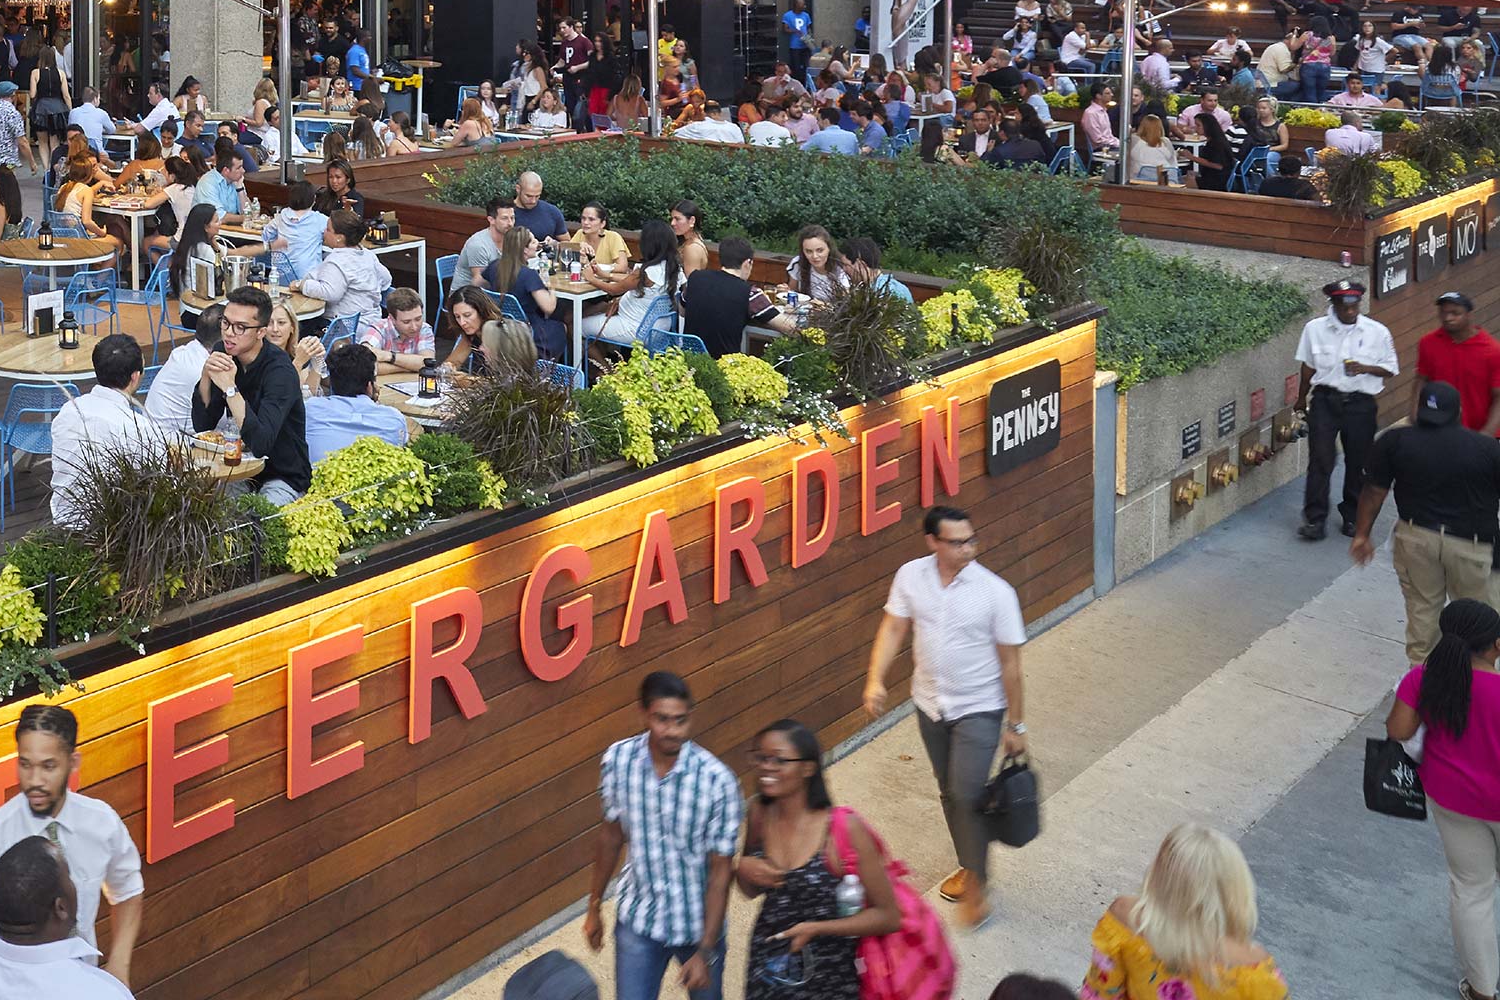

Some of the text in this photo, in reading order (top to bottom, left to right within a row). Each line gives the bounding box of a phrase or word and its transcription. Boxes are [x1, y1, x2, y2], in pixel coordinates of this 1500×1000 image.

[1418, 233, 1448, 256] THE BEET
[1021, 386, 1031, 398] THE
[992, 391, 1059, 456] PENNSY
